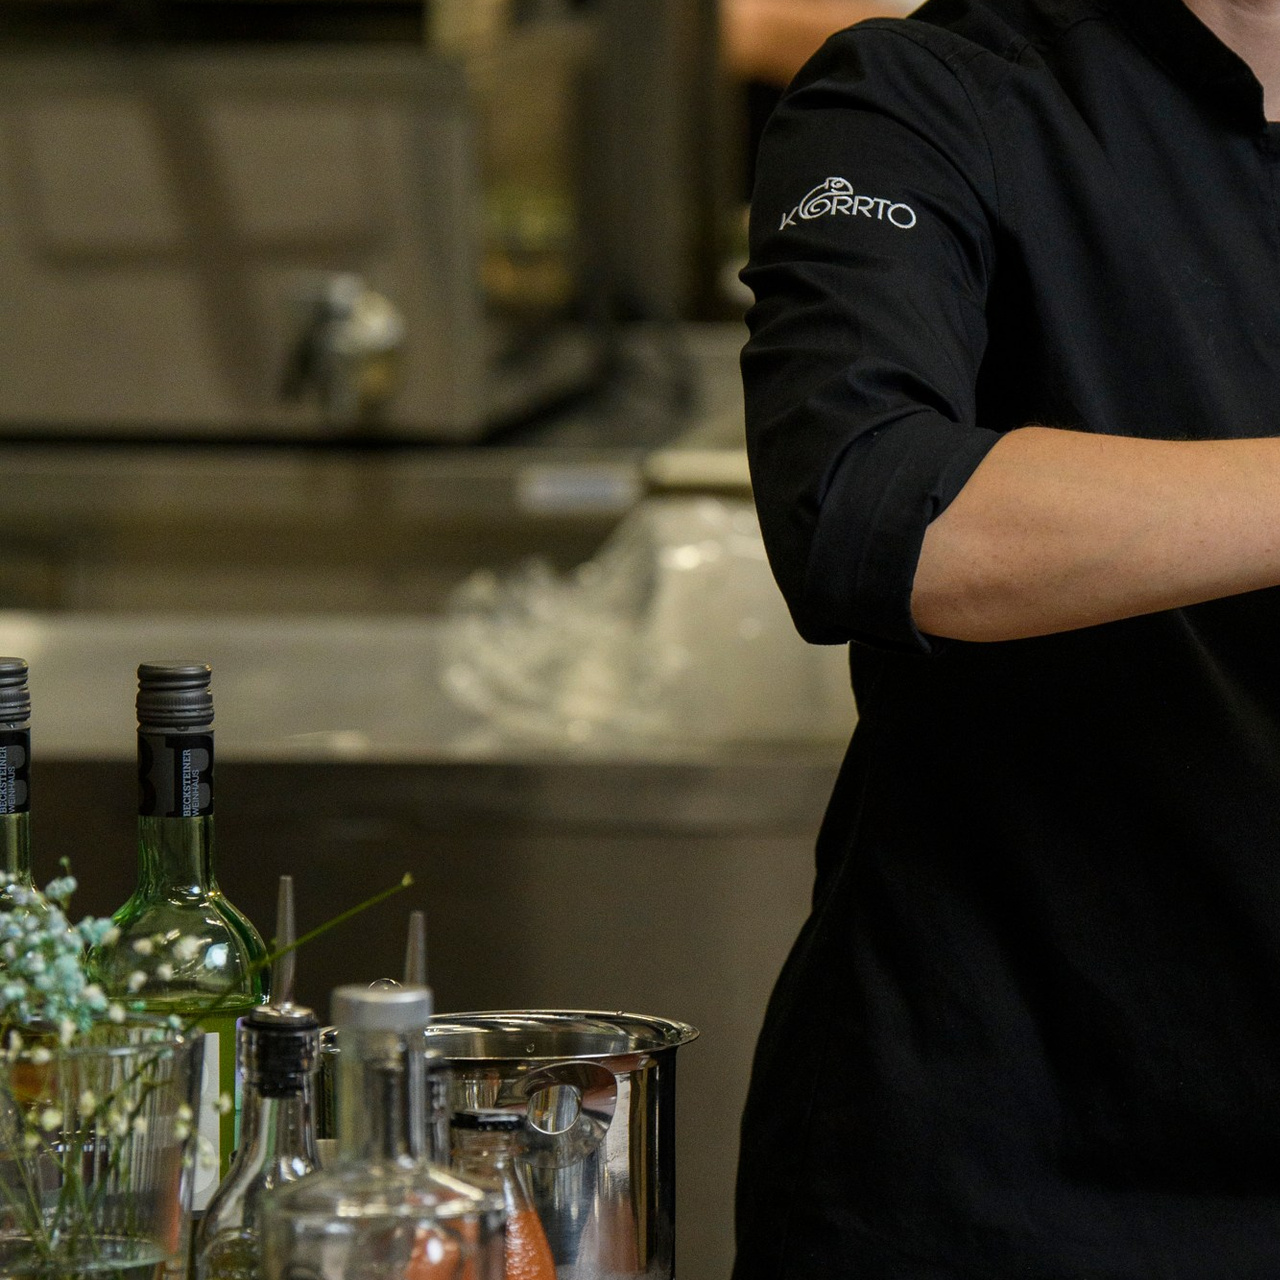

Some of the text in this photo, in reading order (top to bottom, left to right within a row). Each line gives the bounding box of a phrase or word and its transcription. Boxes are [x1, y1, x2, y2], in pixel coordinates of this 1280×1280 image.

[8, 766, 16, 814] WEINHAUS
[182, 749, 191, 817] BECKSTEINER
[191, 769, 200, 817] WEINHAUS
